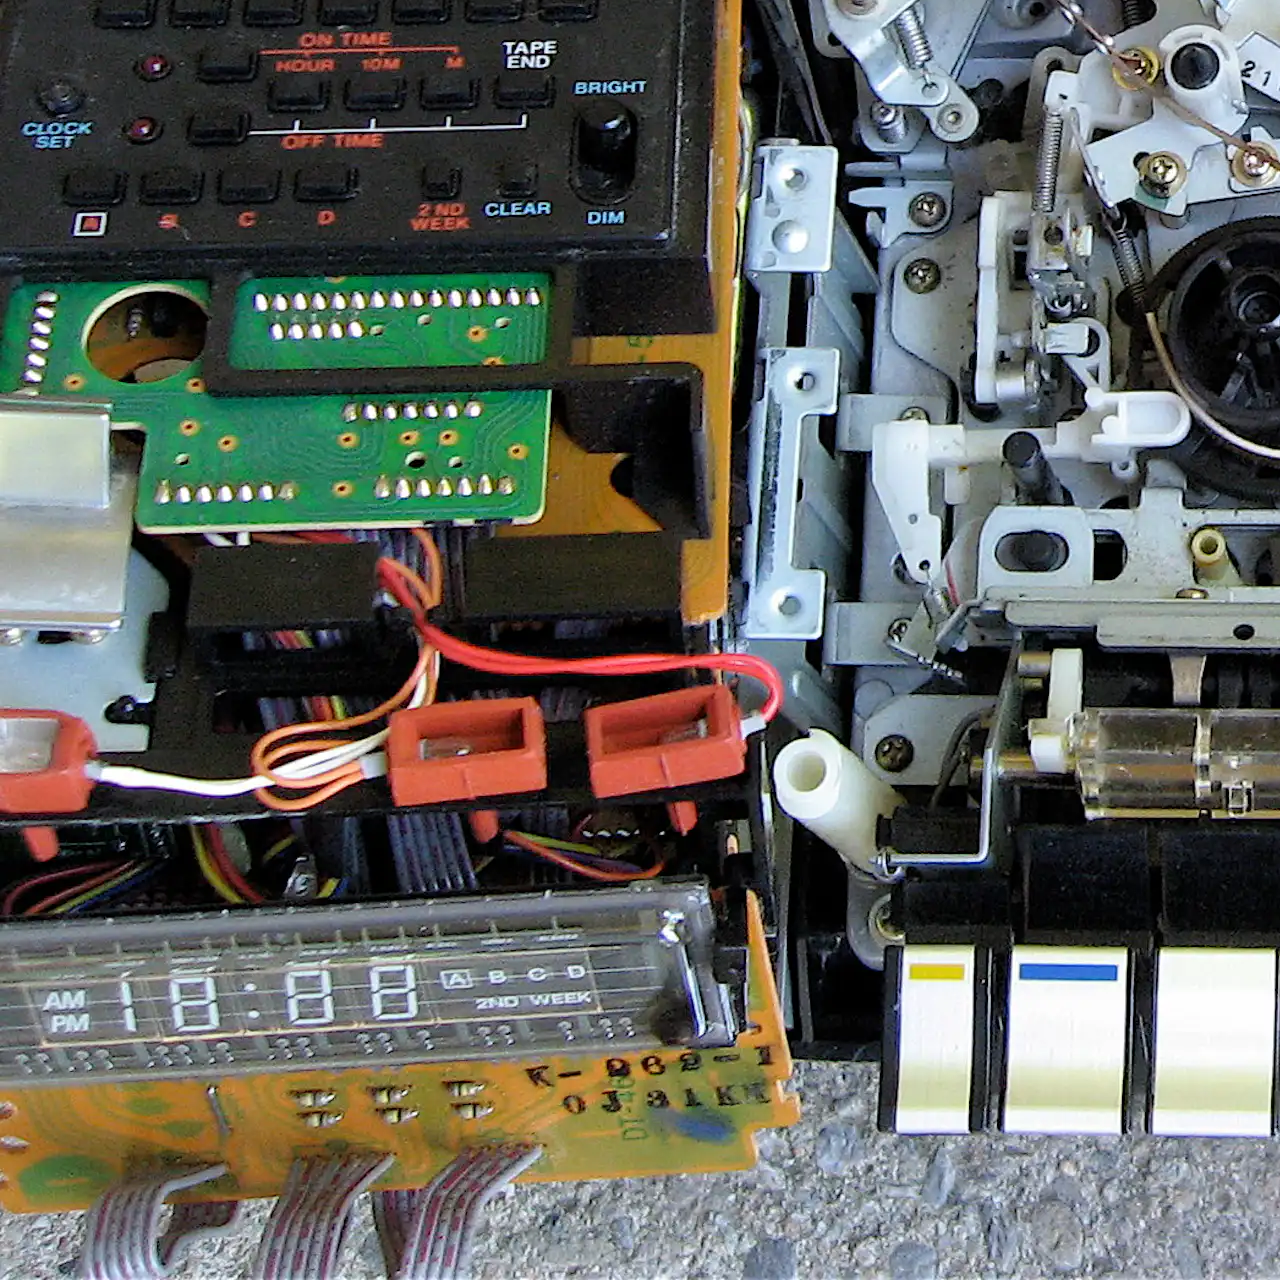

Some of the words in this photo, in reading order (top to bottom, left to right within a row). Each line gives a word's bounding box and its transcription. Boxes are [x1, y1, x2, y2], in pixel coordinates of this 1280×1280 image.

[299, 33, 334, 47] ON
[342, 31, 393, 46] TIME
[502, 40, 558, 55] TAPE
[275, 58, 336, 72] HOUR
[361, 57, 402, 70] 10M
[445, 55, 466, 69] M
[506, 55, 551, 69] END
[574, 80, 648, 95] BRIGHT
[22, 121, 93, 136] CLOCK
[34, 135, 76, 149] SET
[280, 135, 326, 150] OFF
[332, 133, 385, 148] TIME
[484, 200, 551, 217] CLEAR
[238, 211, 258, 228] C
[317, 209, 336, 226] D
[410, 216, 471, 232] WEEK
[587, 210, 625, 225] DIM
[449, 971, 467, 986] A
[488, 970, 508, 984] B
[526, 967, 548, 982] C
[566, 964, 587, 979] D
[42, 989, 86, 1011] AM
[475, 995, 521, 1010] 2ND
[529, 990, 593, 1006] WEEK
[51, 1012, 90, 1033] PM
